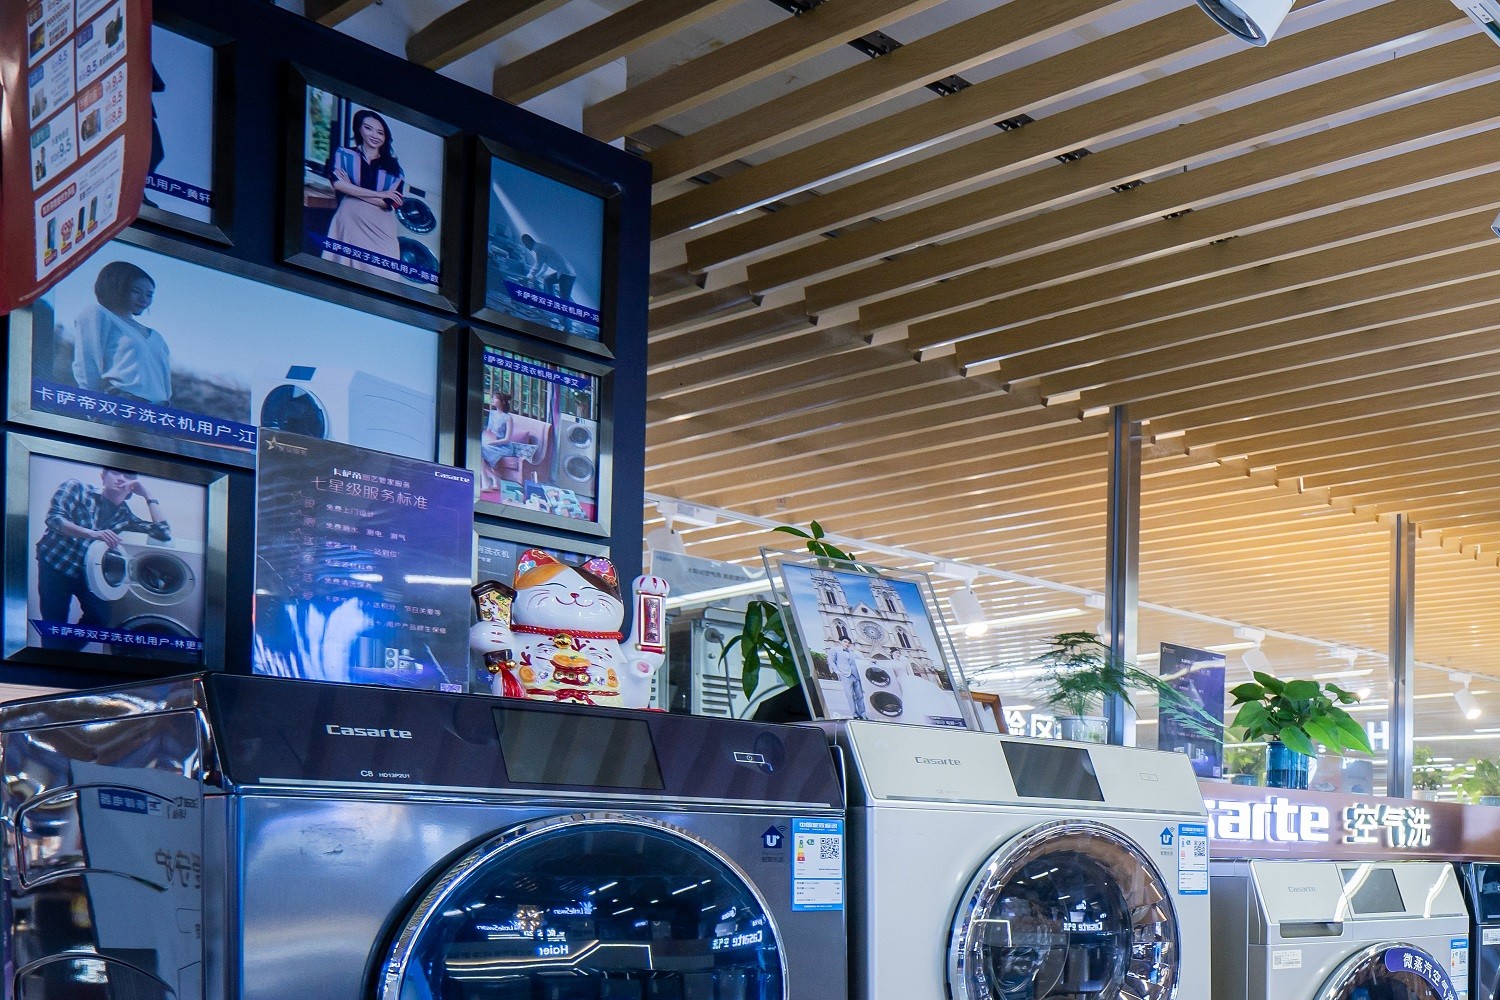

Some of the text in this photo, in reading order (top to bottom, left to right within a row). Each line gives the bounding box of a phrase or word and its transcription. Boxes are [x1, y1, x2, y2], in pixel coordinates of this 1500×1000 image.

[35, 386, 256, 445] 卡萨帝双子洗衣机用户-江
[311, 476, 428, 510] 七星级服务标准
[326, 724, 413, 739] Casarte
[915, 756, 961, 766] Casarte
[1344, 802, 1431, 848] 空气洗
